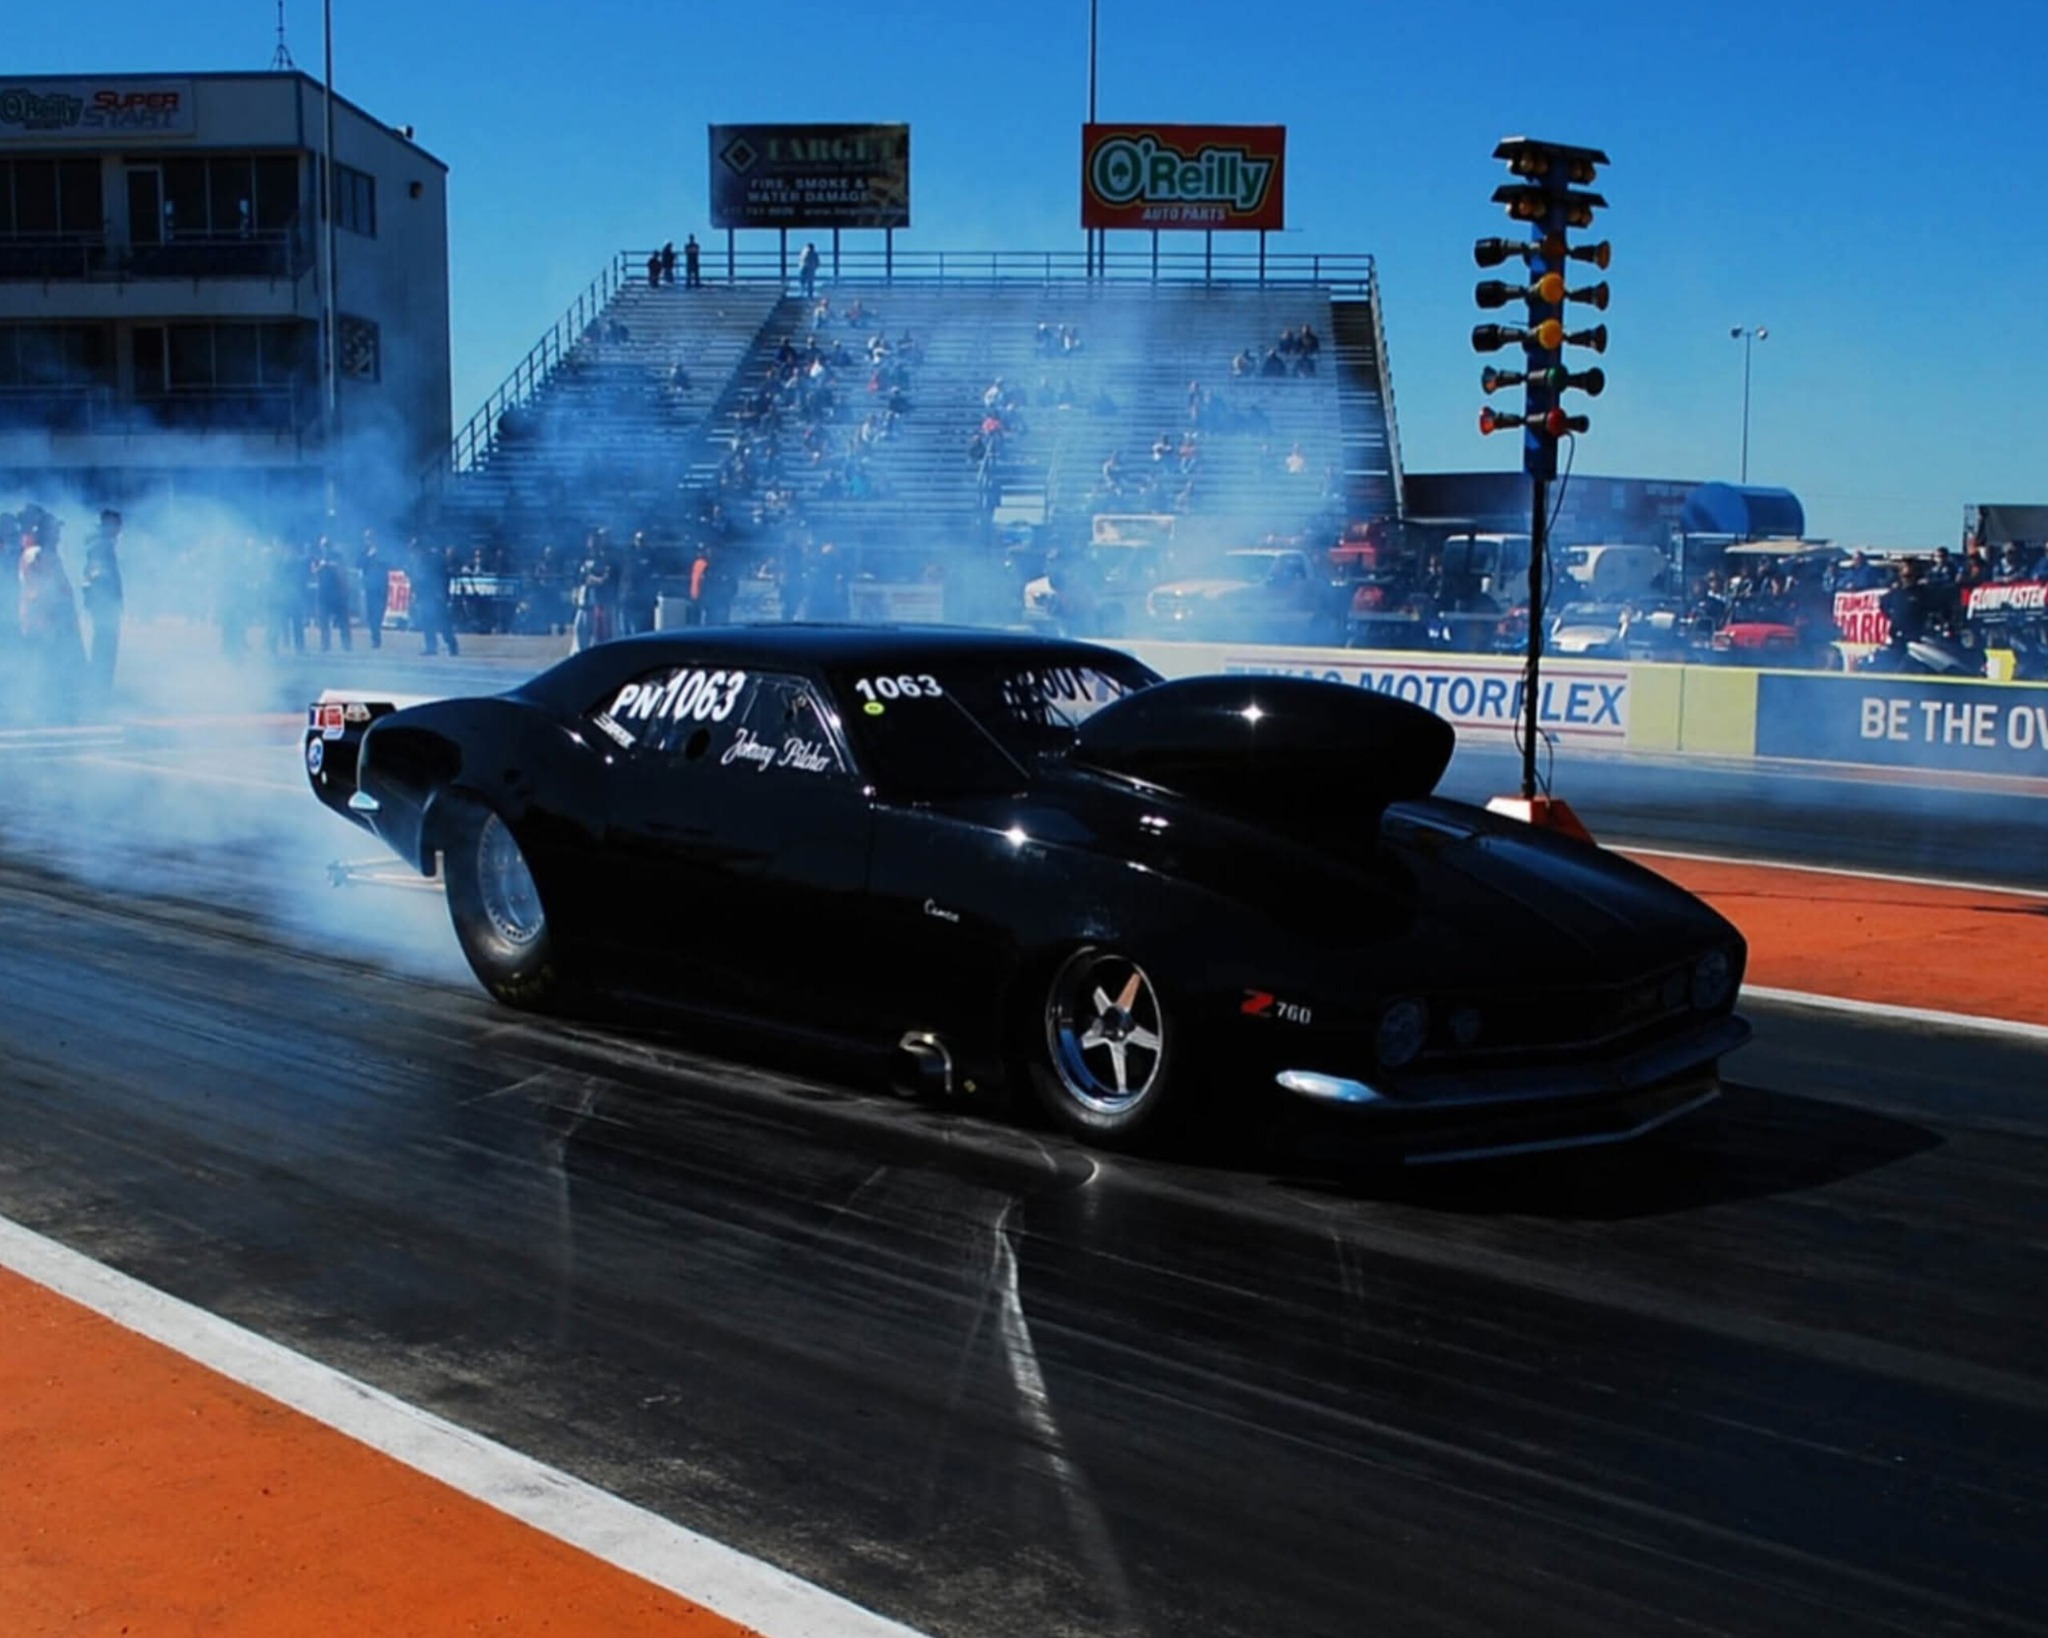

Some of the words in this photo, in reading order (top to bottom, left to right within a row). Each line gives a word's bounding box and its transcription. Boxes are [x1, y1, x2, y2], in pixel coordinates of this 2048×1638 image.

[1094, 138, 1269, 208] O'Reilly
[1142, 207, 1178, 220] AUTO
[1181, 207, 1227, 220] PARTS
[855, 674, 943, 700] 1063
[1860, 698, 1912, 741] BE
[1920, 701, 1998, 747] THE
